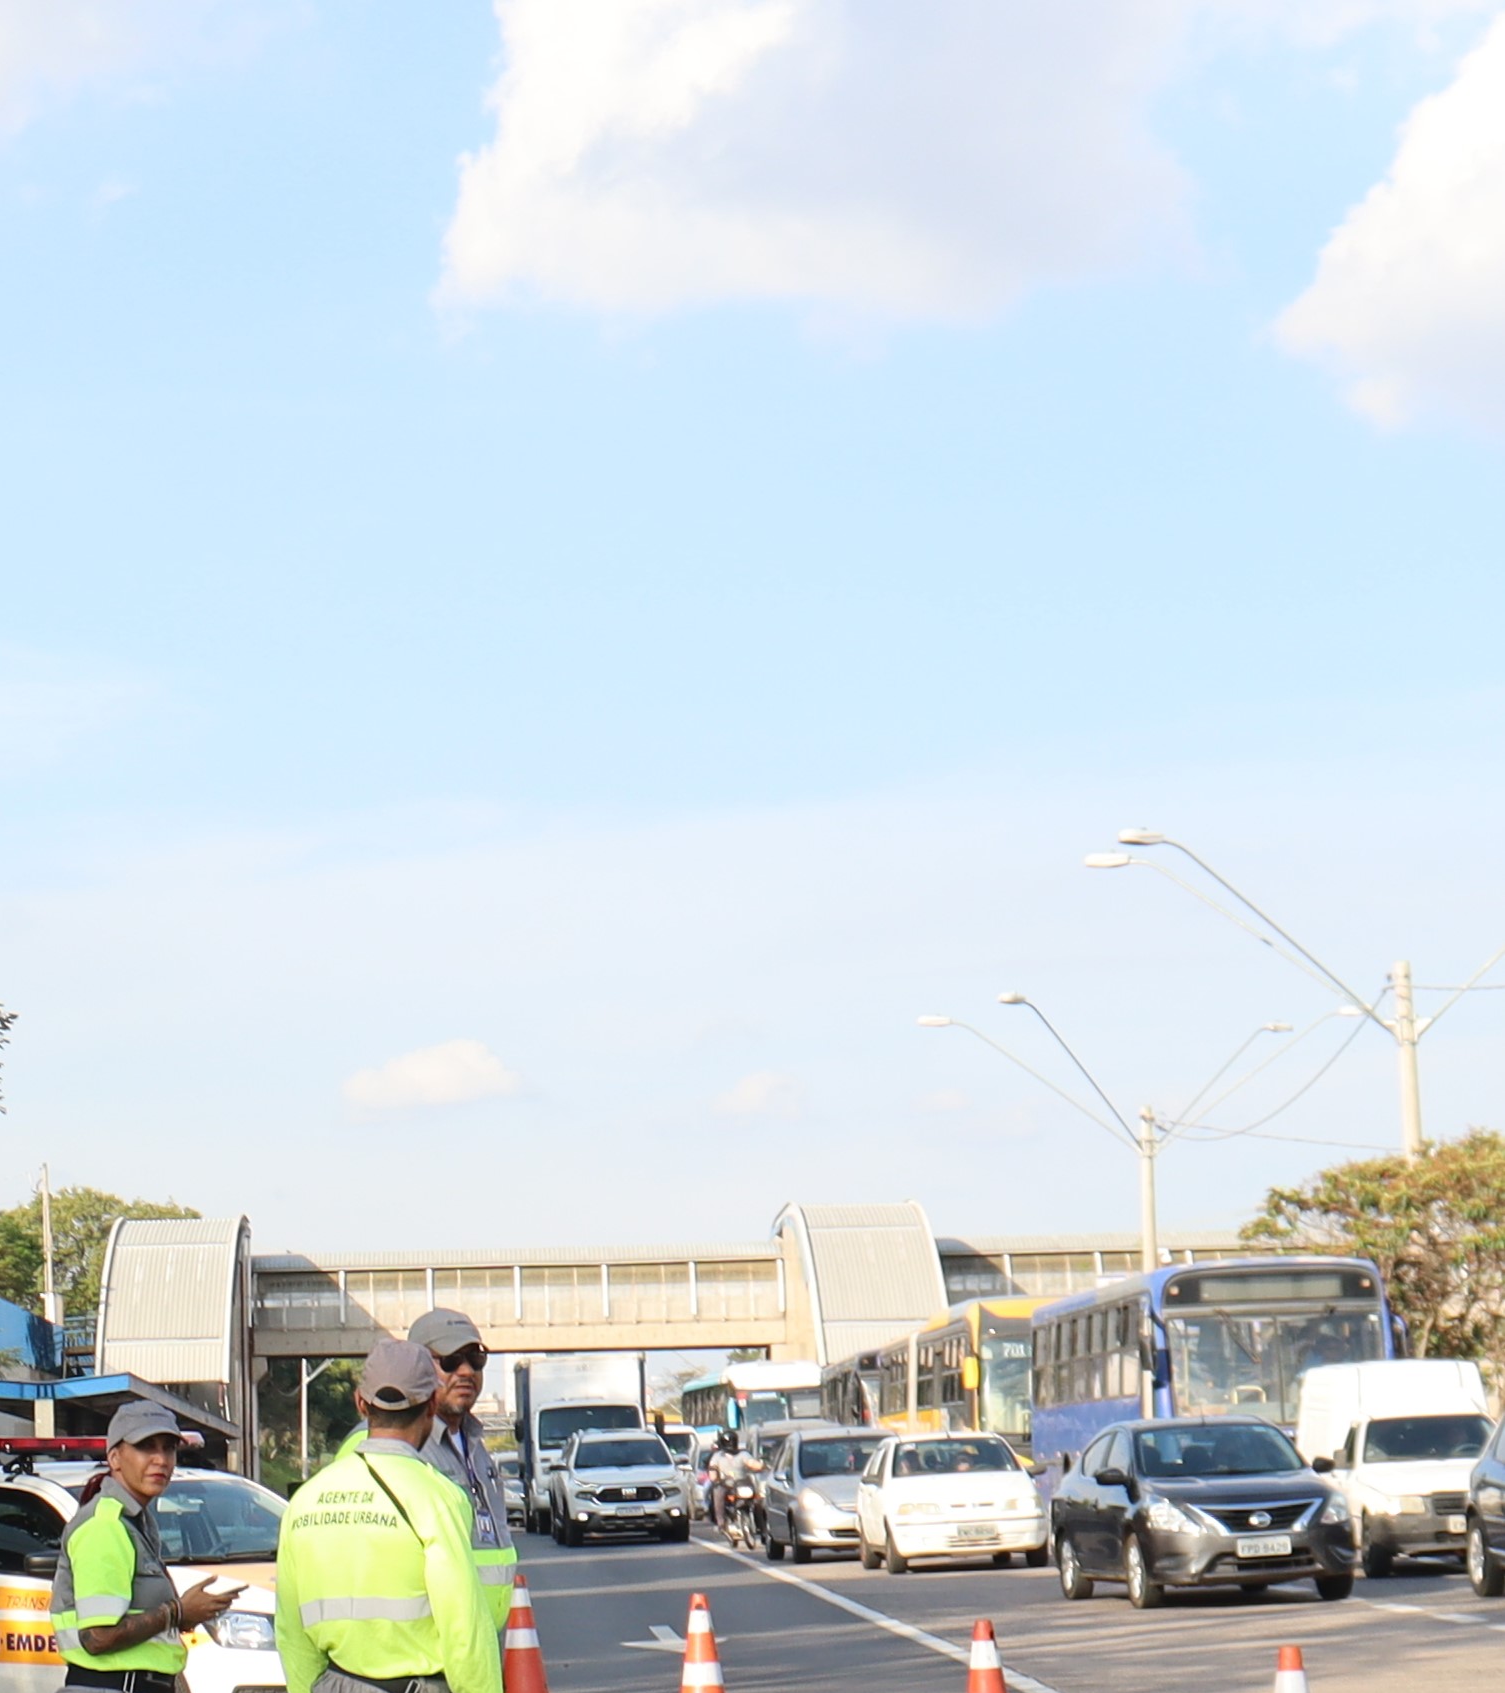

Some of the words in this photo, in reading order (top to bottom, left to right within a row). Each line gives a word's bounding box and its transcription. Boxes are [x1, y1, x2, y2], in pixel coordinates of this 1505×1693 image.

[317, 1491, 360, 1505] AGENTE
[361, 1491, 375, 1504] DA
[353, 1511, 398, 1528] URBANA
[6, 1633, 58, 1653] EMDE
